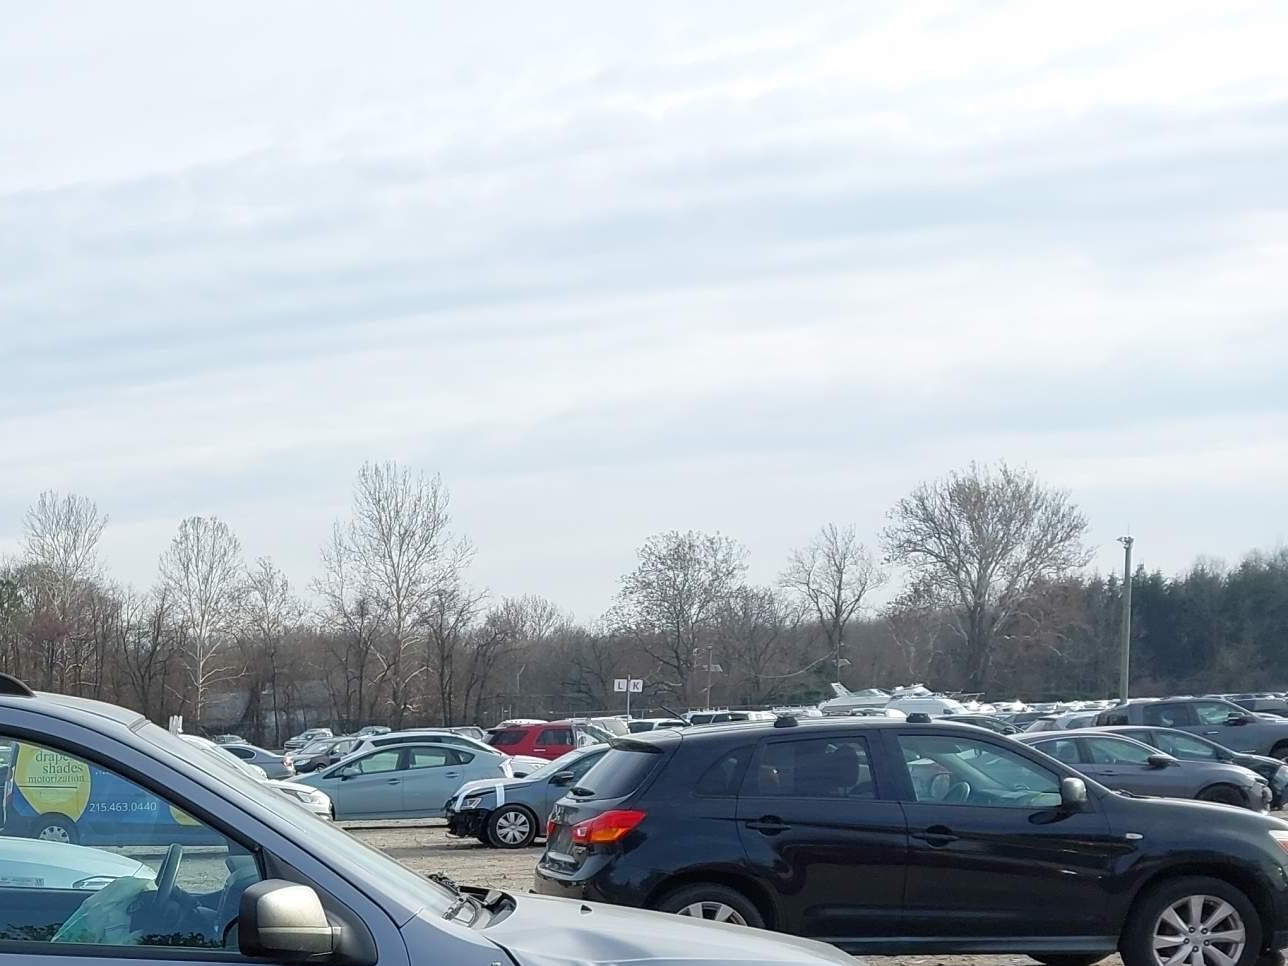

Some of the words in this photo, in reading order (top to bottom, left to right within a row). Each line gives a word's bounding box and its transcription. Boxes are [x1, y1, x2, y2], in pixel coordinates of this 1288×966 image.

[617, 681, 623, 690] L
[632, 681, 640, 690] K
[42, 762, 83, 774] shades
[28, 775, 85, 784] motorization
[89, 801, 157, 812] 215.463.0440
